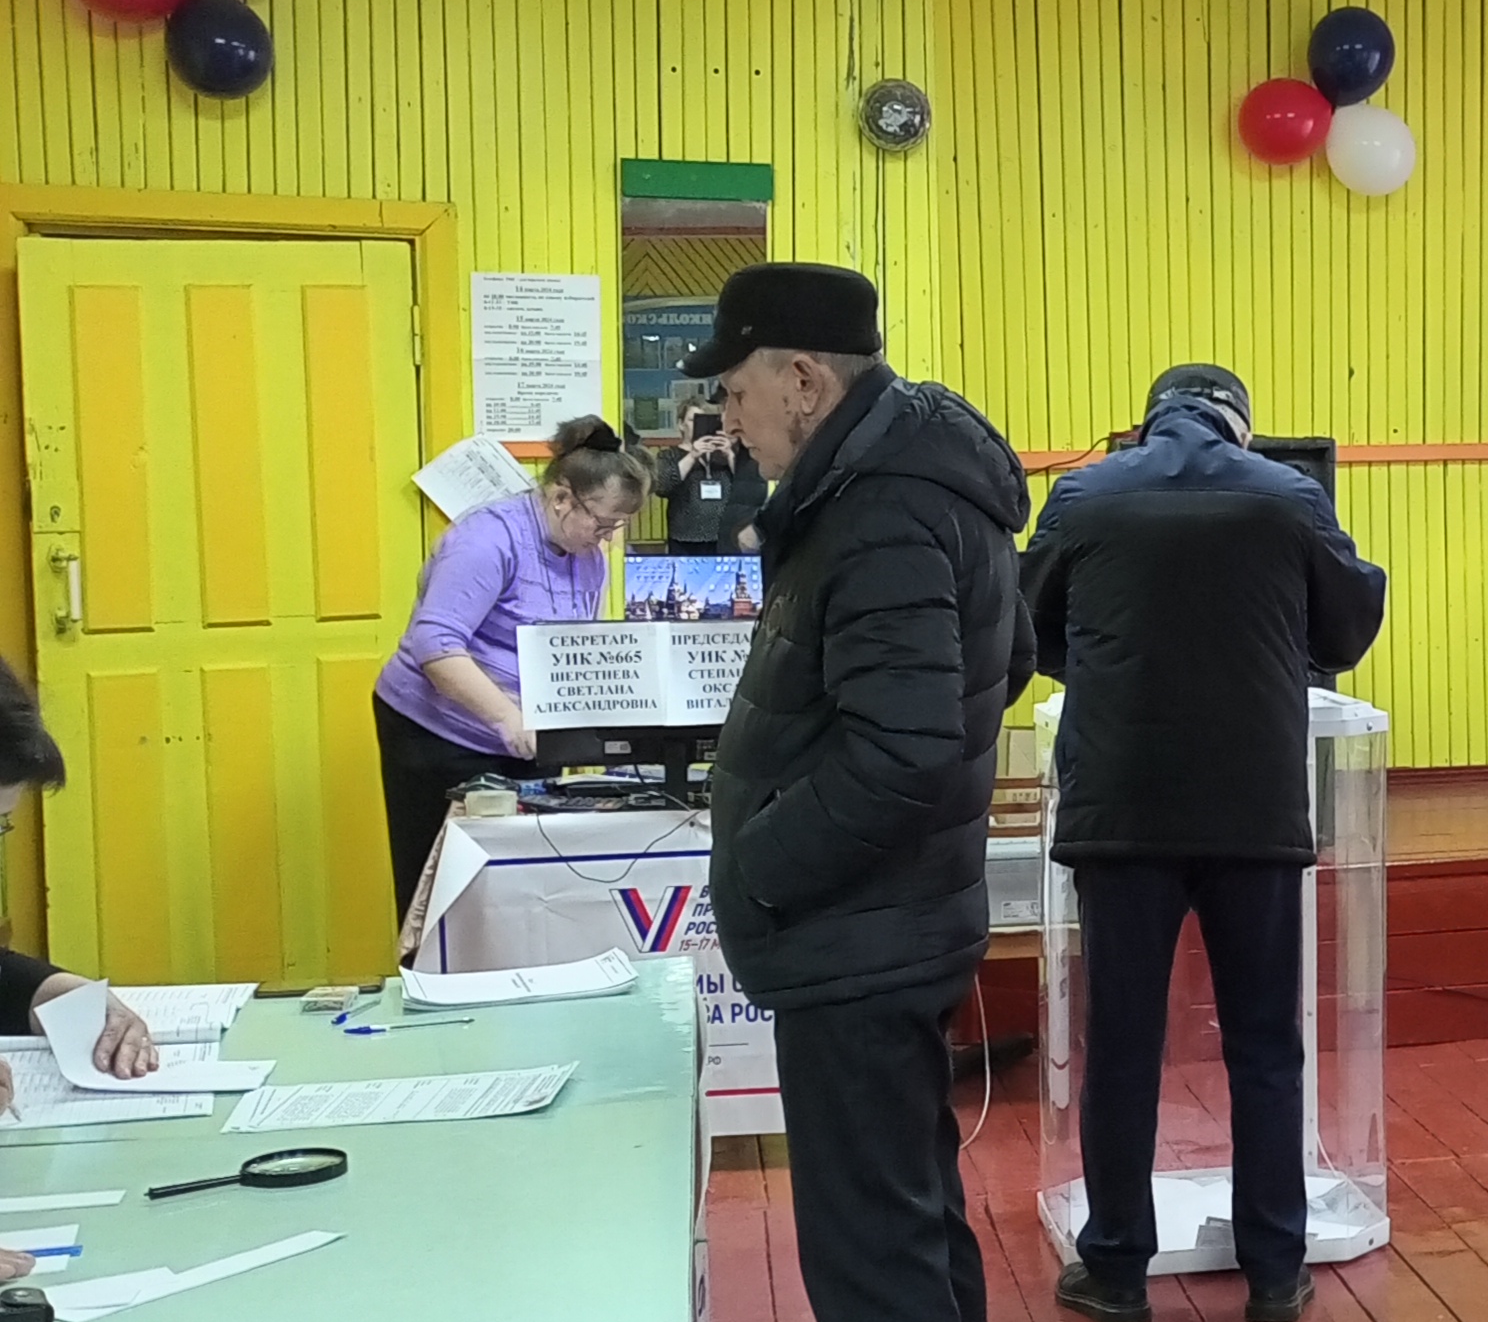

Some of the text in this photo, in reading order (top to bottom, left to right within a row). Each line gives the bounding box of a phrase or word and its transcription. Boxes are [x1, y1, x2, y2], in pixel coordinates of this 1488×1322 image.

[549, 634, 638, 648] СЕКРЕТАРЬ
[671, 633, 750, 646] ПРЕДСЕДА
[551, 650, 643, 667] УИК №665
[687, 650, 727, 664] УИК
[550, 669, 640, 683] ШЕРСТНЕВА
[556, 684, 635, 697] СВЕТЛАНА
[702, 683, 733, 694] ОКС
[534, 698, 658, 714] АЛЕКСАНДРОВНА
[684, 921, 717, 936] РОС
[731, 1003, 774, 1024] РОС
